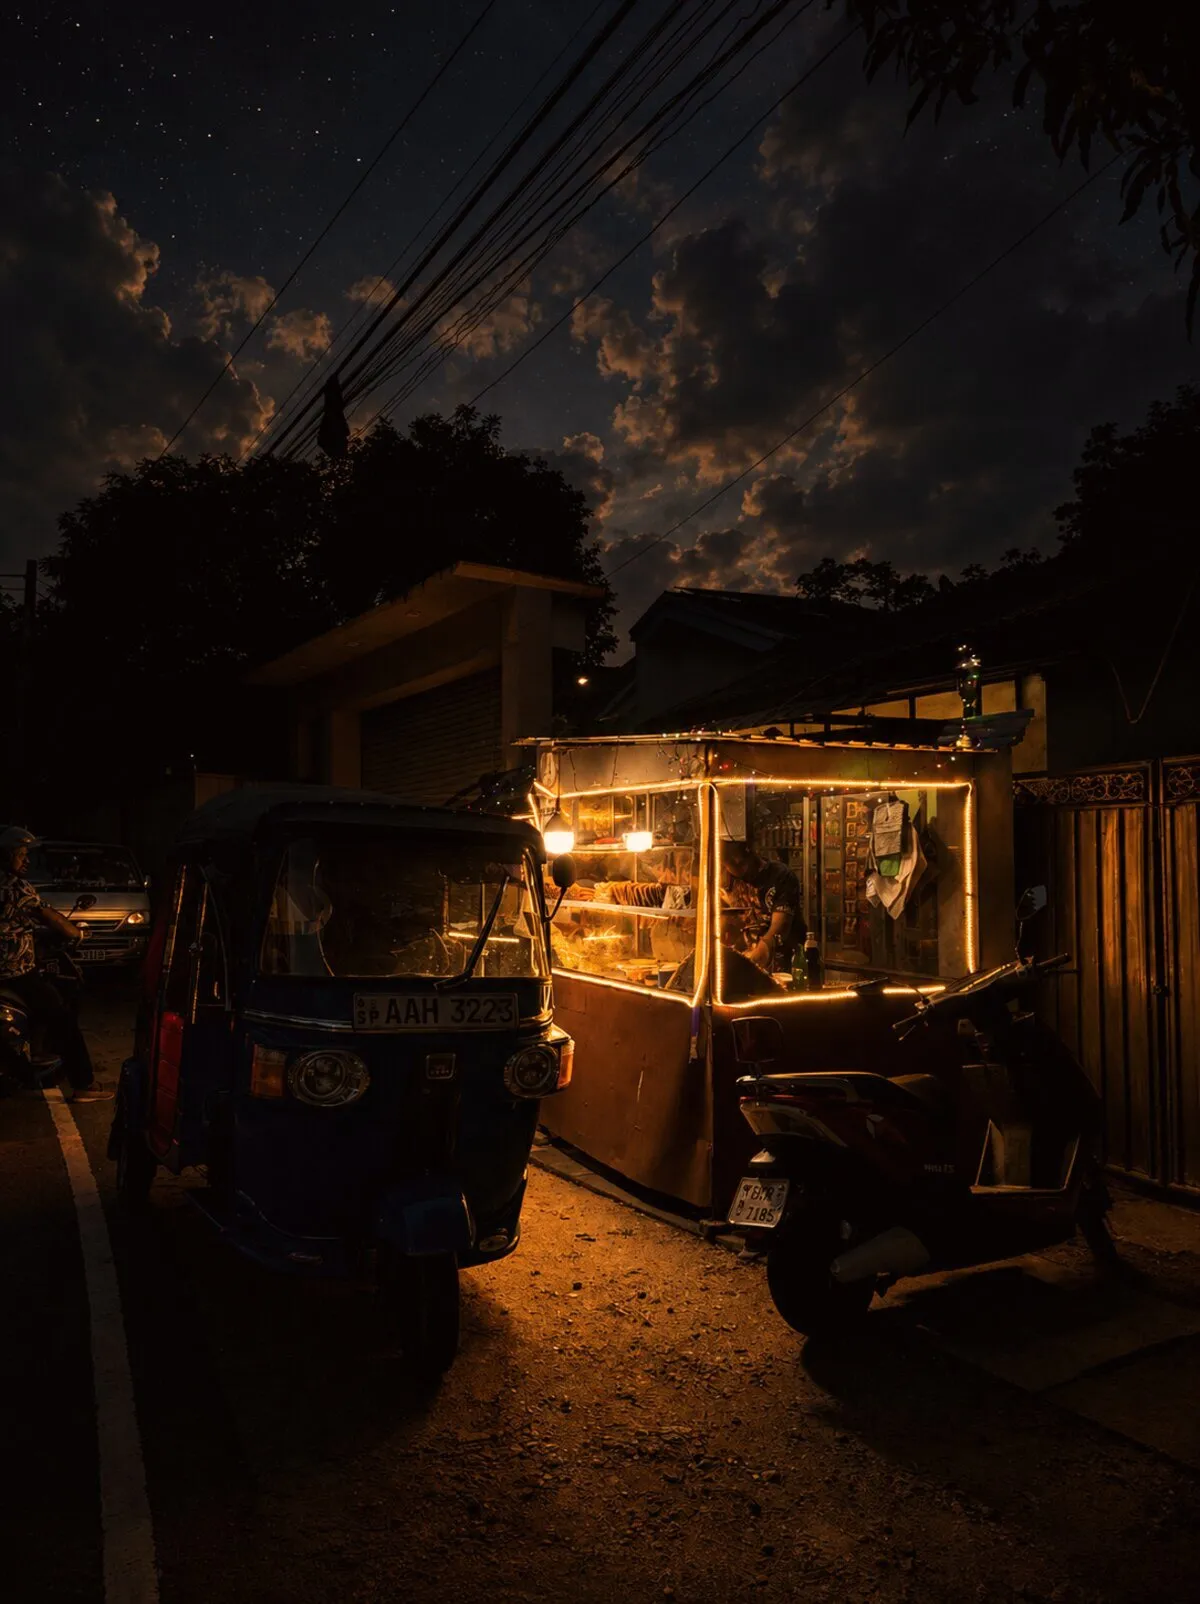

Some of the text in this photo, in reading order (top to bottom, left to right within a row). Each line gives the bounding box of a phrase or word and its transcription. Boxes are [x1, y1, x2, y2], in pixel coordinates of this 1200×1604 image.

[357, 998, 513, 1024] SP AAH 3223
[745, 1206, 774, 1222] 7185
